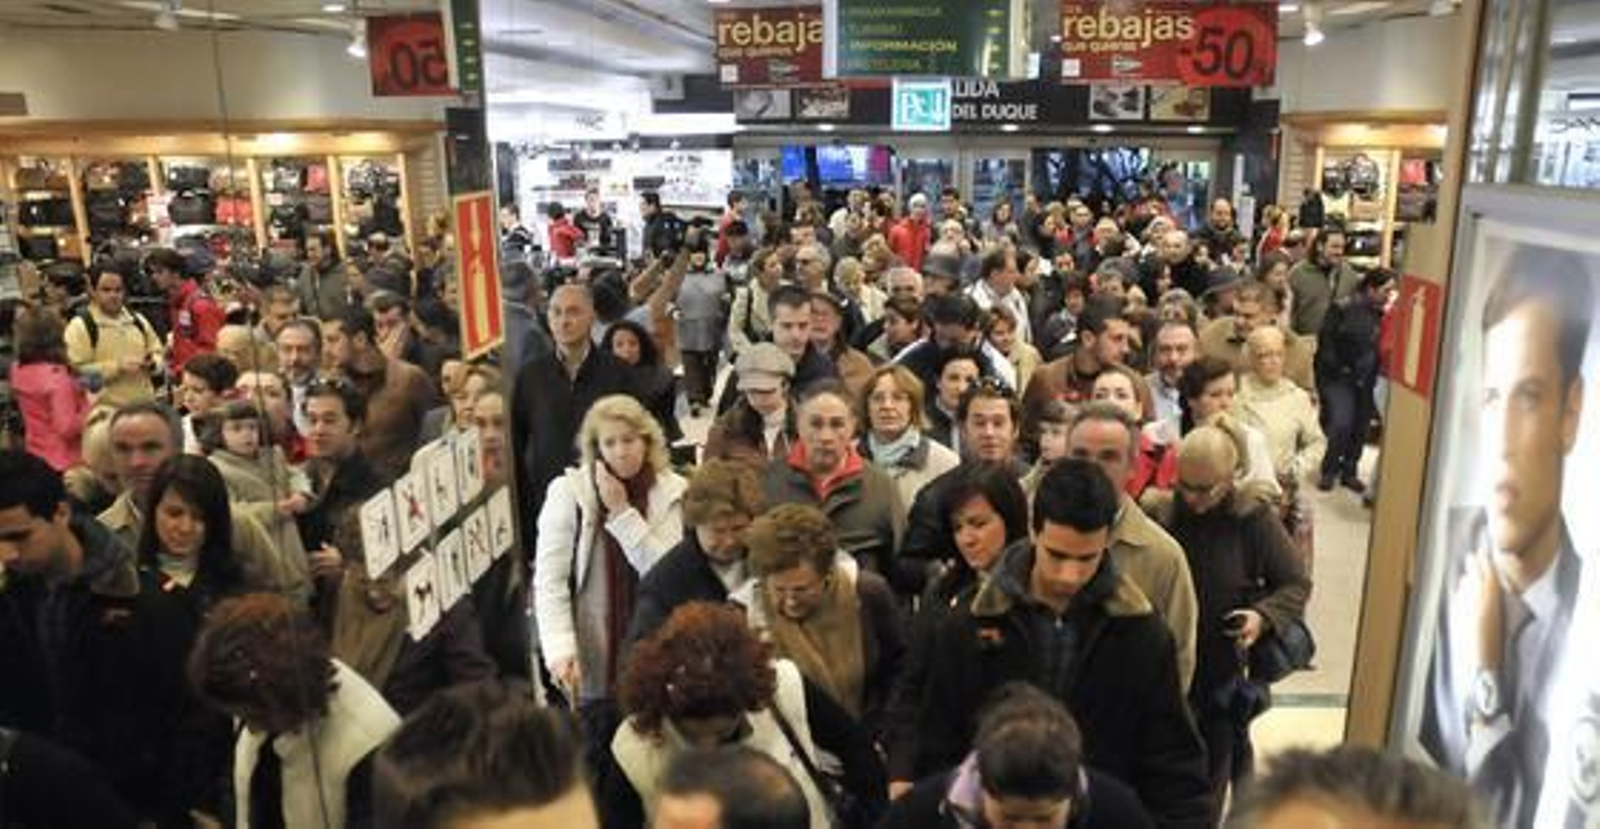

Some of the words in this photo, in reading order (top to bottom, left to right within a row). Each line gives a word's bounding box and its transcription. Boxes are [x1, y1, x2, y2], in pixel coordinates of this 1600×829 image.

[718, 12, 822, 53] rebaja
[1063, 7, 1195, 48] rebajas
[1062, 41, 1086, 53] que
[952, 80, 1000, 98] LIDA
[952, 103, 978, 120] DEL
[981, 103, 1039, 120] DUQUE
